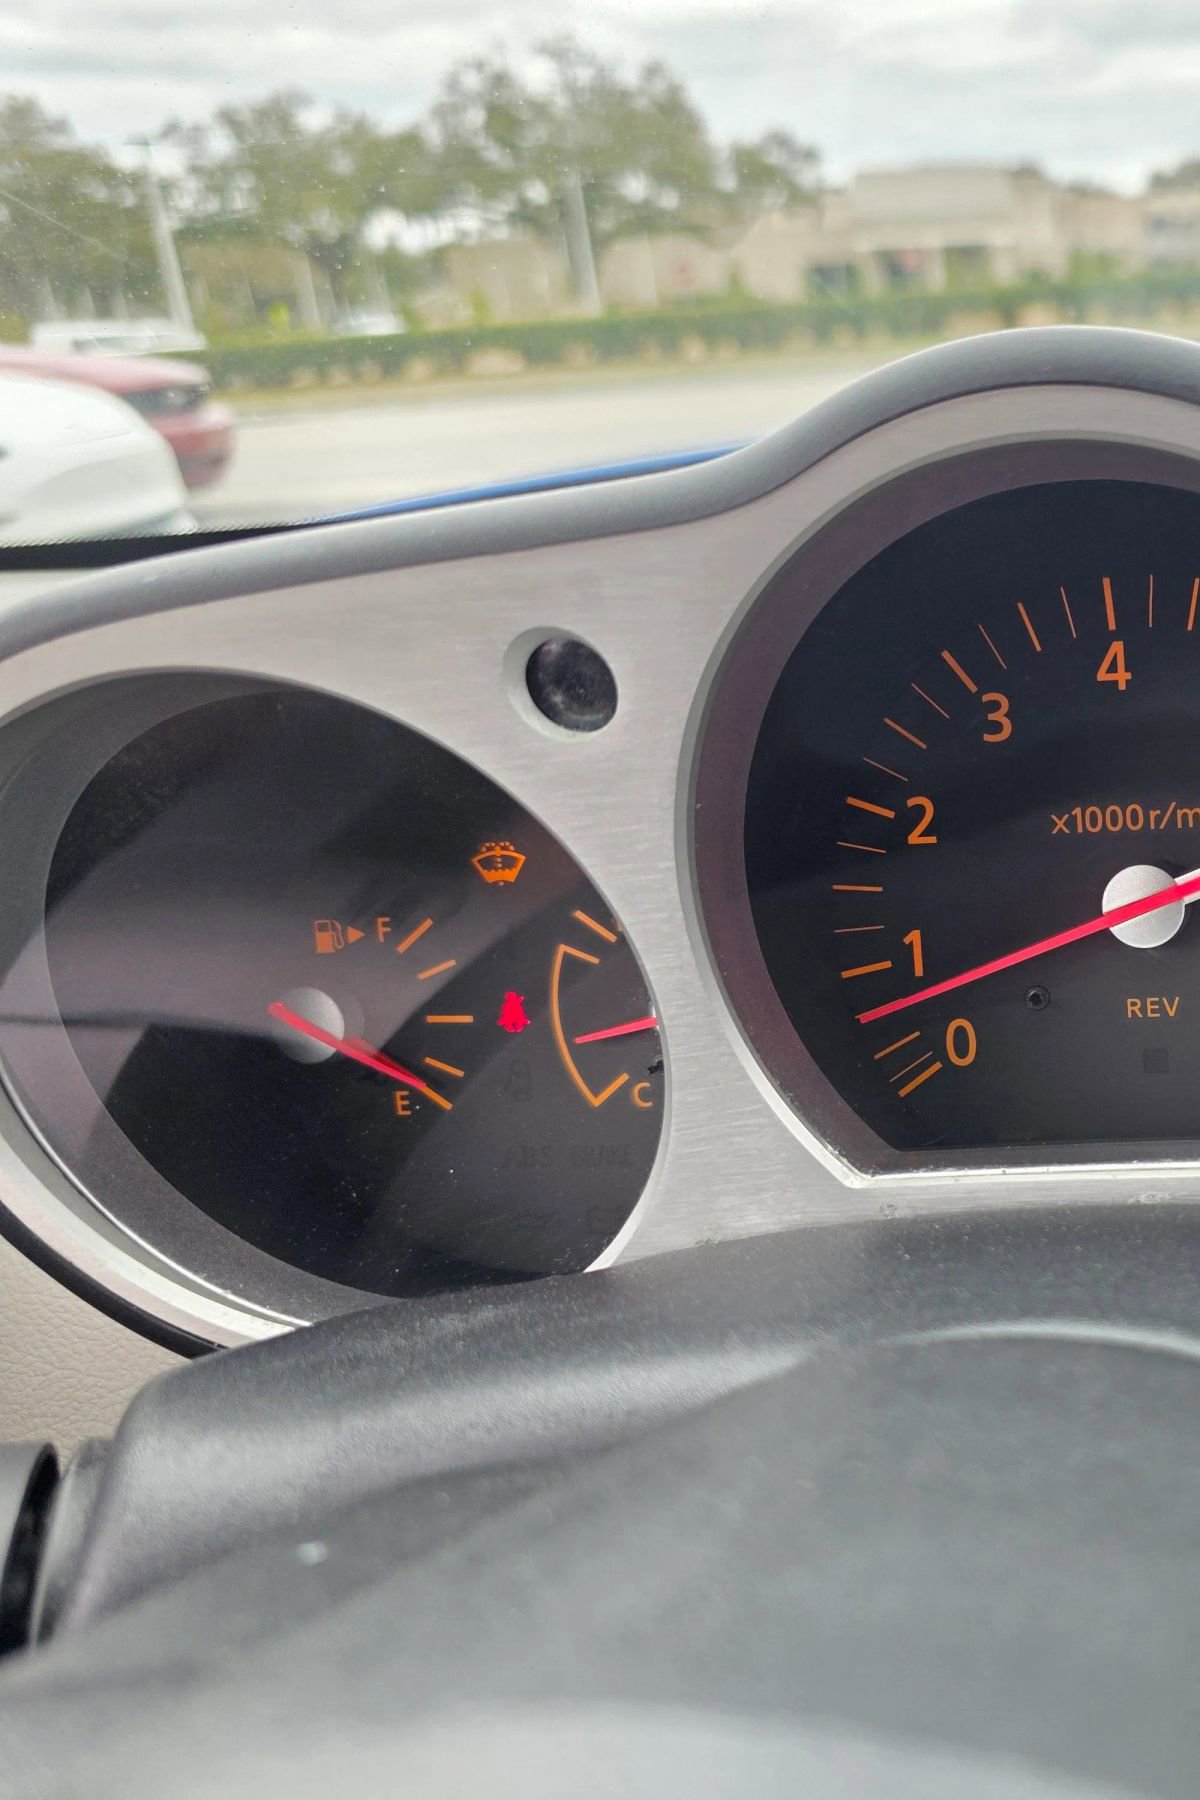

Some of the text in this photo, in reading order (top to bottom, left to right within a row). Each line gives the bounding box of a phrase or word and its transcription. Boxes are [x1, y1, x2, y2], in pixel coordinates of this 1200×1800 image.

[1095, 640, 1132, 690] 4
[982, 693, 1012, 743] 3
[906, 796, 939, 846] 2
[376, 916, 391, 942] F
[902, 929, 924, 978] 1
[1125, 996, 1180, 1019] REV
[945, 1018, 977, 1067] 0
[394, 1091, 410, 1116] E
[632, 1081, 653, 1108] C
